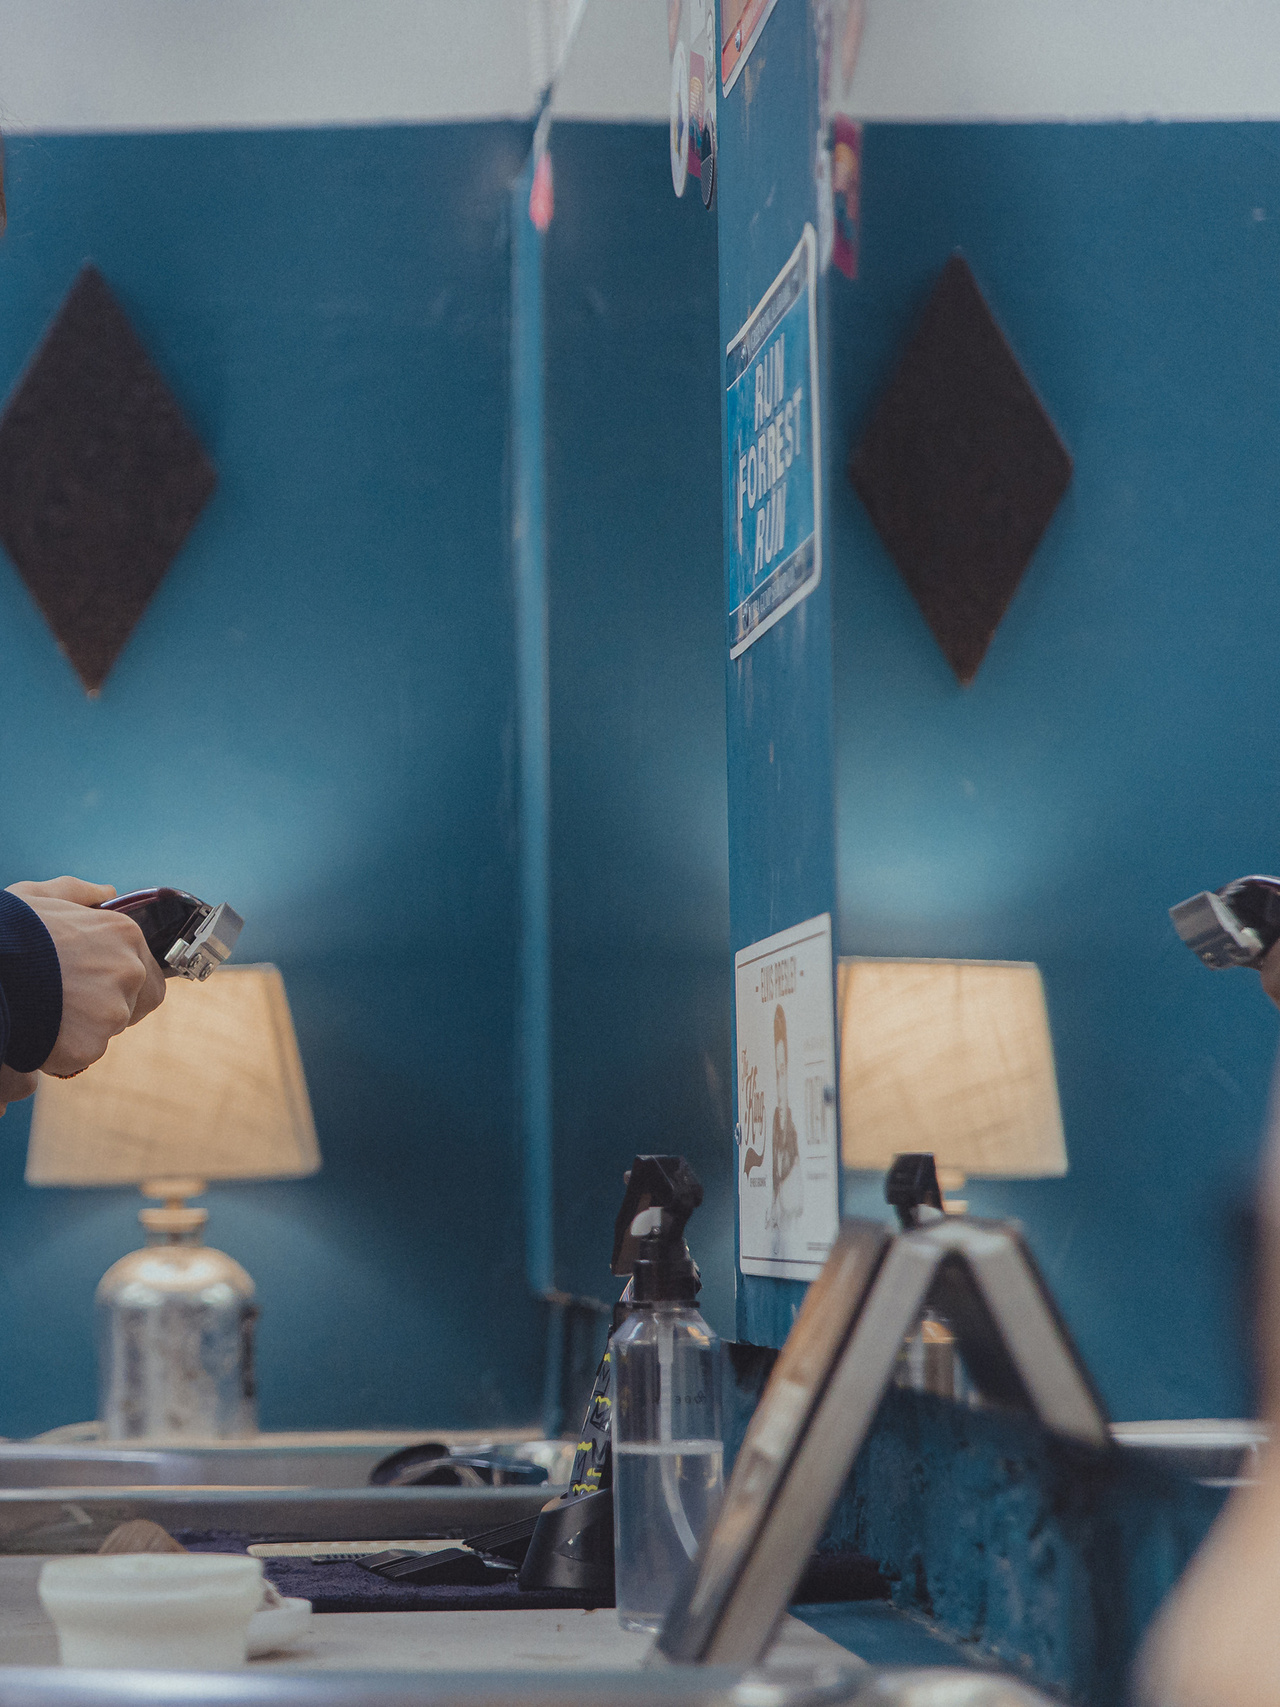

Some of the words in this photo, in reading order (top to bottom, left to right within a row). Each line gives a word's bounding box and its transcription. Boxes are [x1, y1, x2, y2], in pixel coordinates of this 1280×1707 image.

[754, 332, 785, 432] RUN
[739, 386, 802, 520] FORREST
[754, 482, 787, 576] RUN
